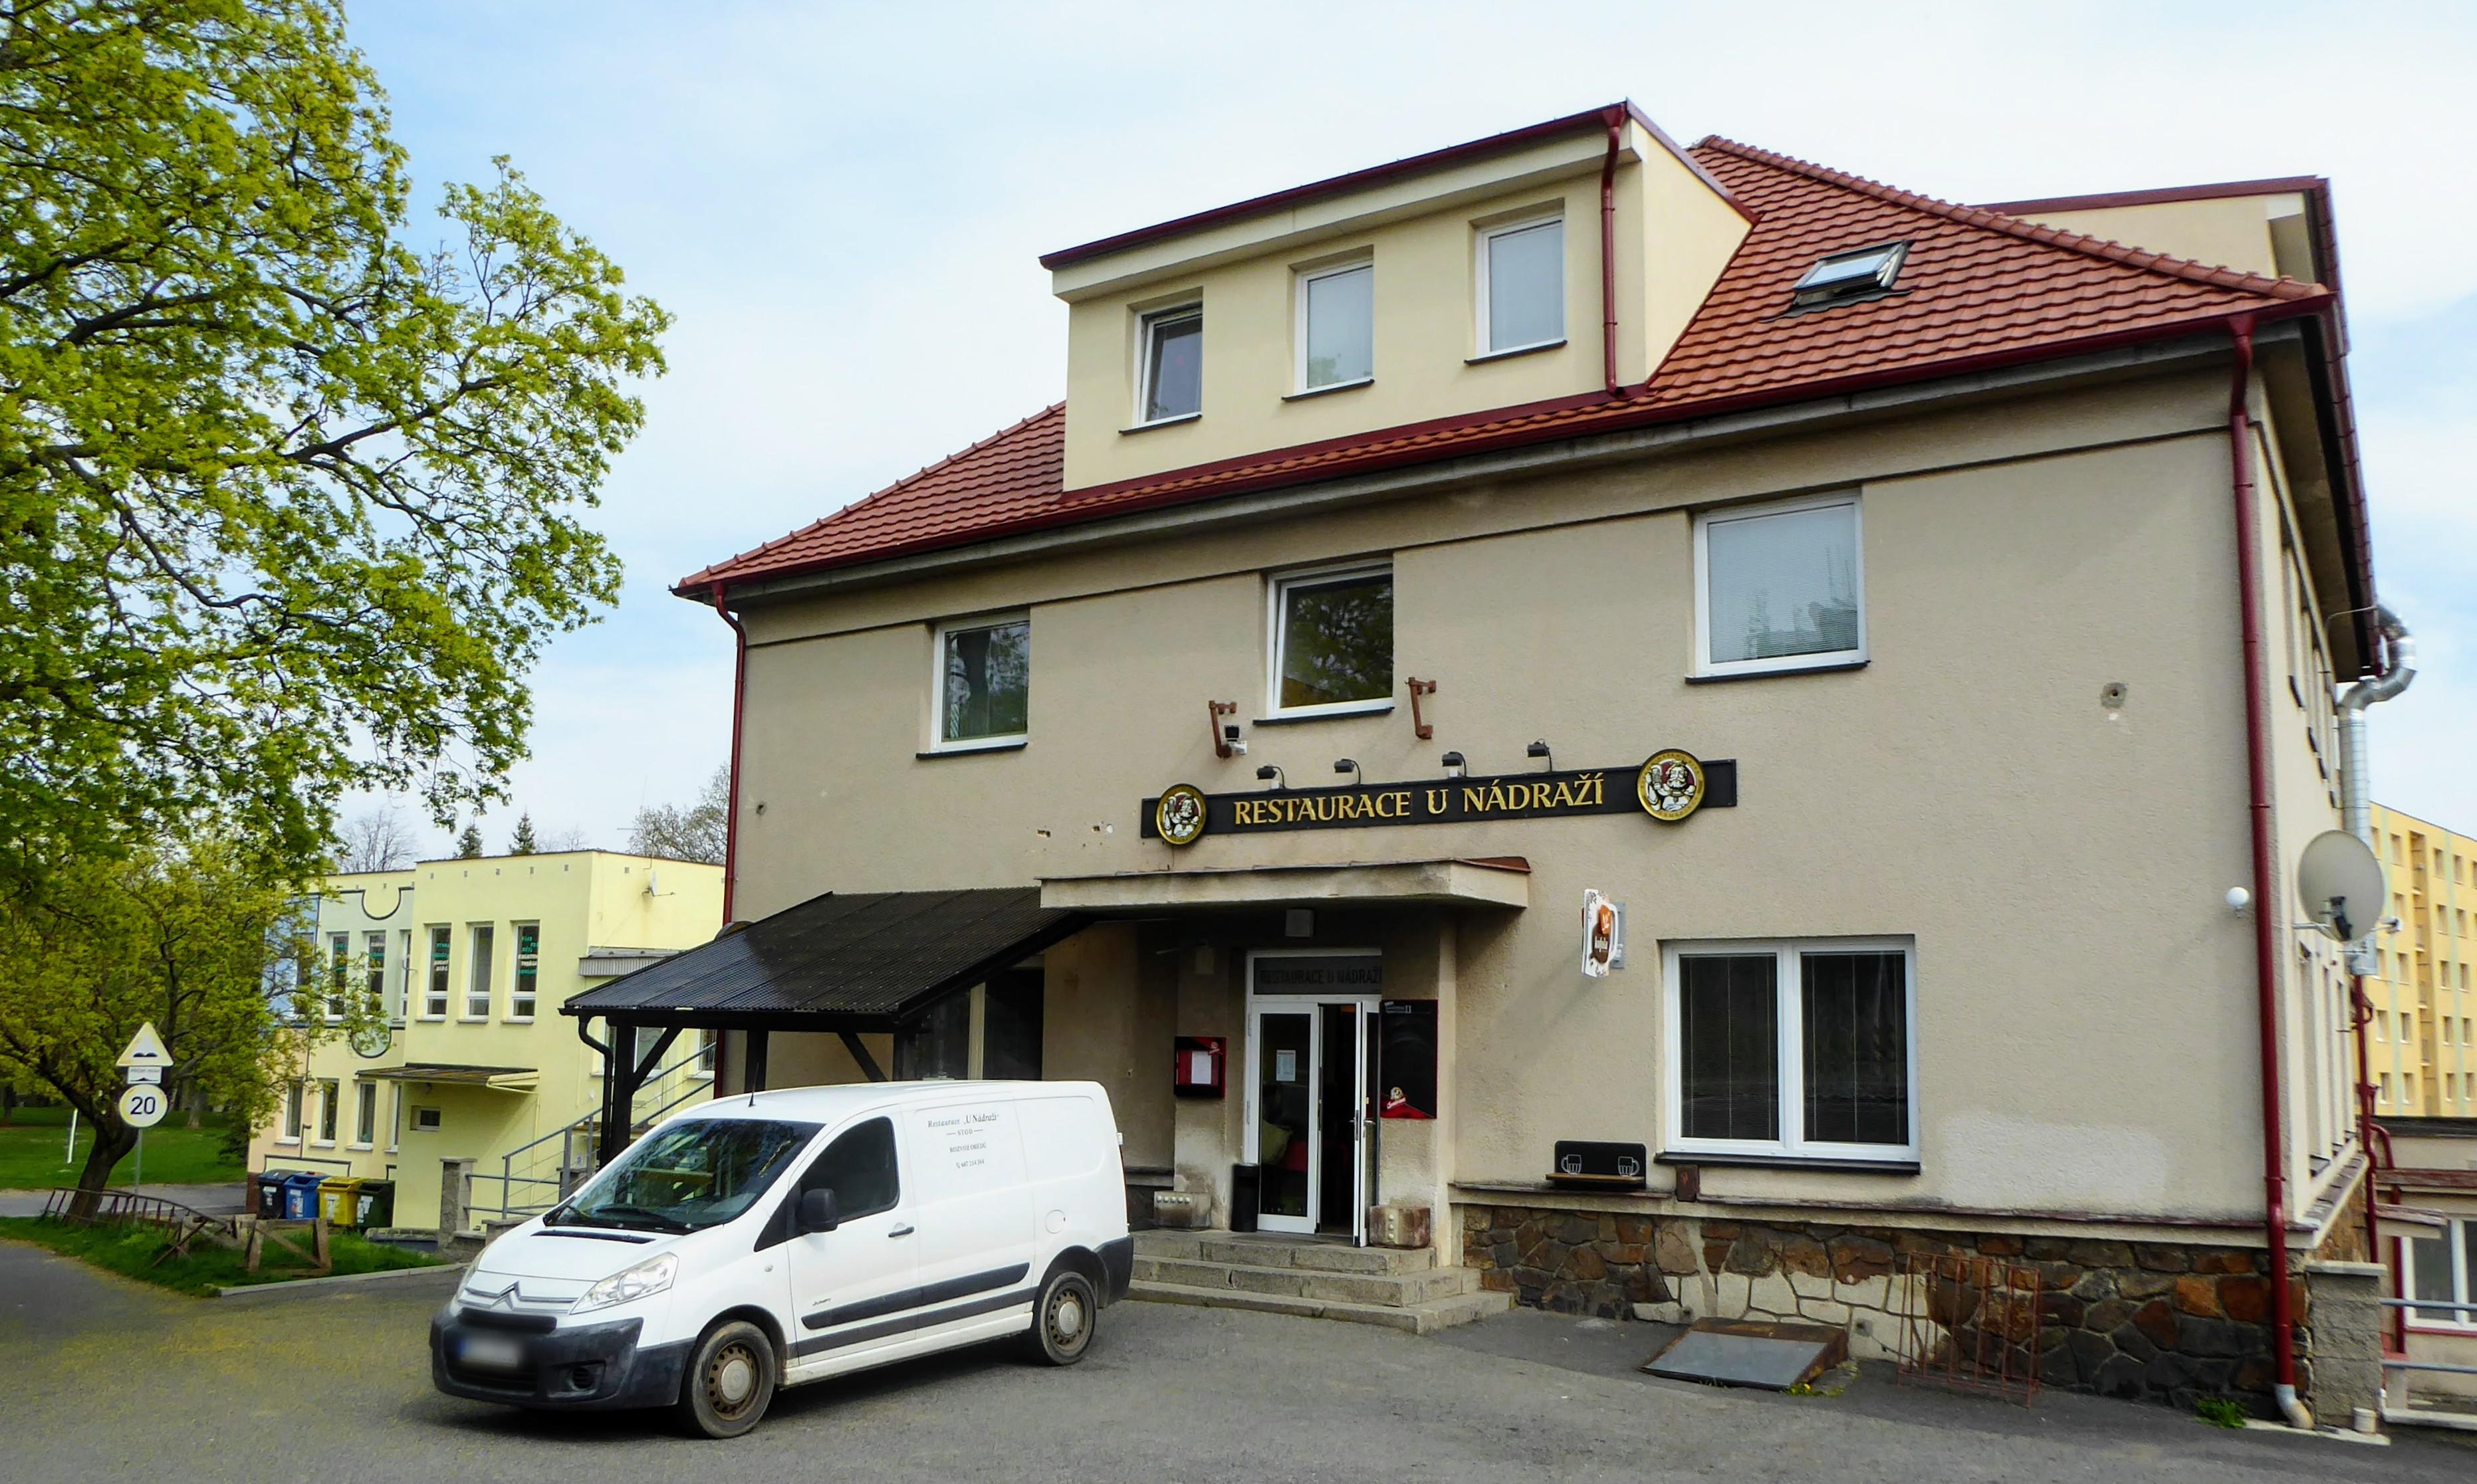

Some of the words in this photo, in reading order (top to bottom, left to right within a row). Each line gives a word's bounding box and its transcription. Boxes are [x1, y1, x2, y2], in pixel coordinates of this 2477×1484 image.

[1234, 791, 1411, 825] RESTAURACE
[1426, 789, 1449, 815] U
[1464, 772, 1605, 813] NÁDRAŽÍ
[130, 1096, 156, 1114] 20
